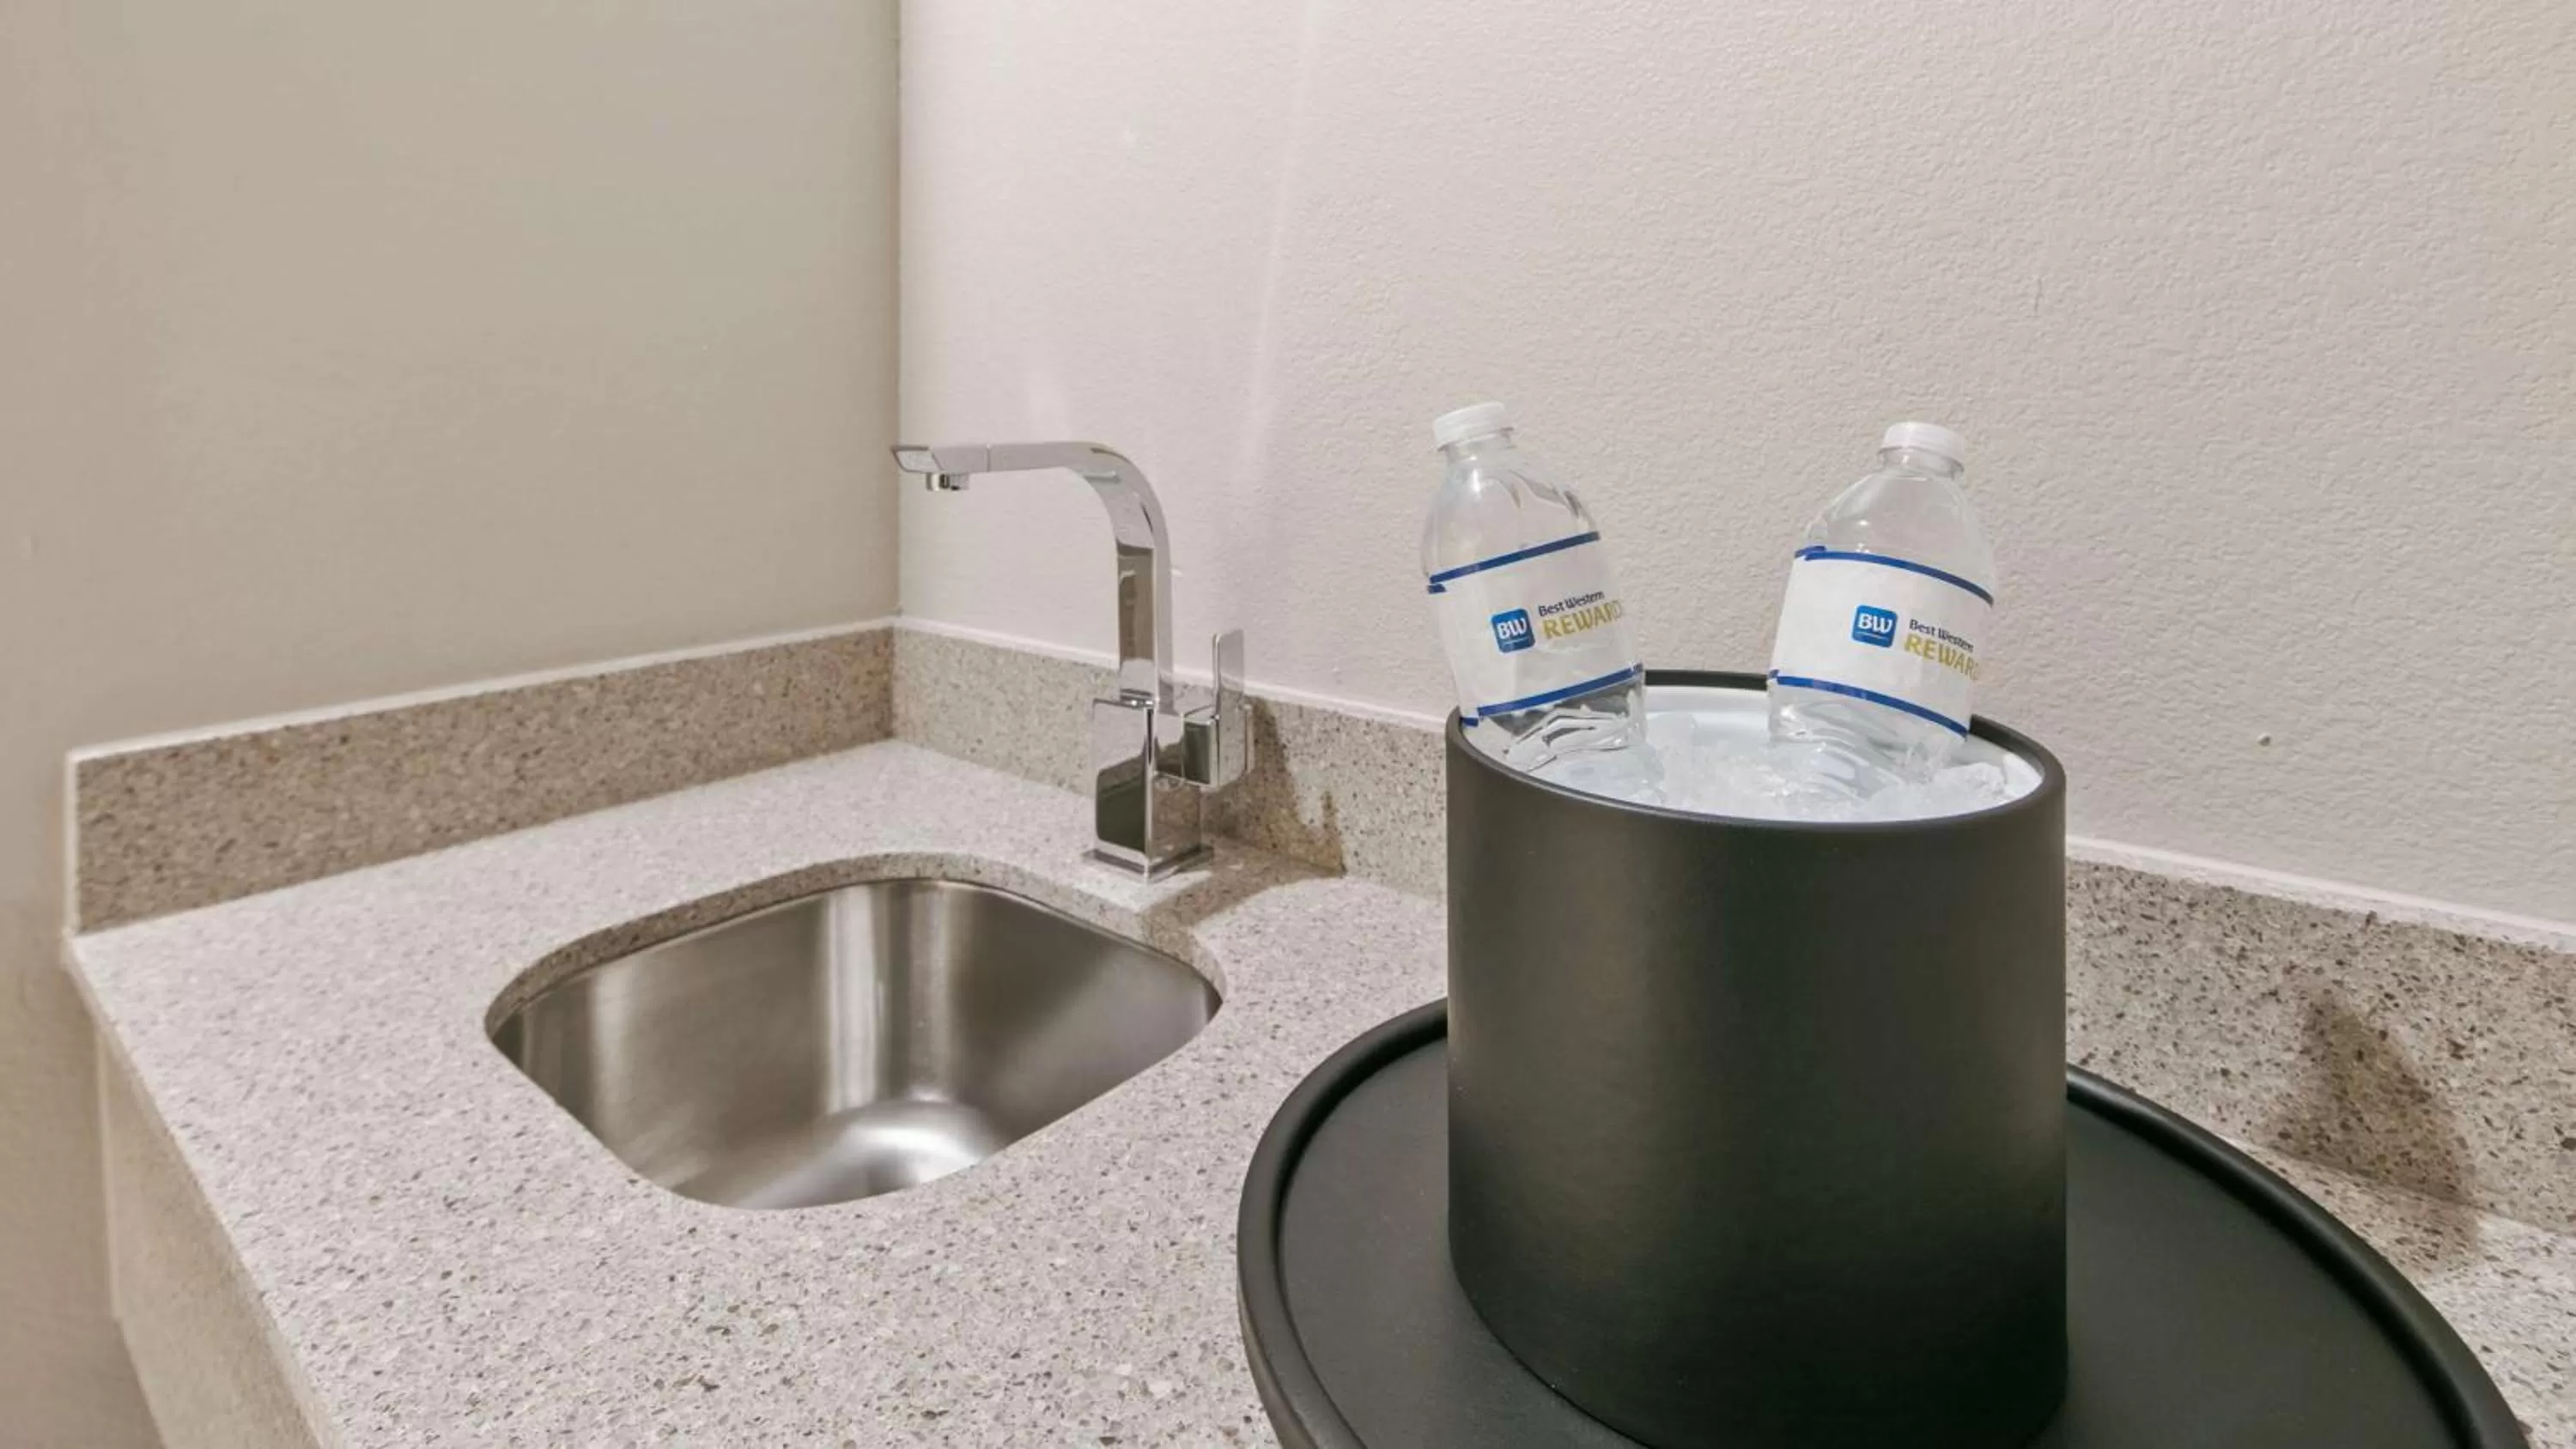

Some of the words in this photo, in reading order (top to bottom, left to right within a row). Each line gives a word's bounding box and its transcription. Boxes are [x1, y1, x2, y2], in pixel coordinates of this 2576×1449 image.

[1538, 602, 1564, 617] Best
[1564, 591, 1605, 609] Western
[1497, 617, 1527, 640] BW
[1857, 613, 1893, 634] BW
[1909, 618, 1935, 636] Best
